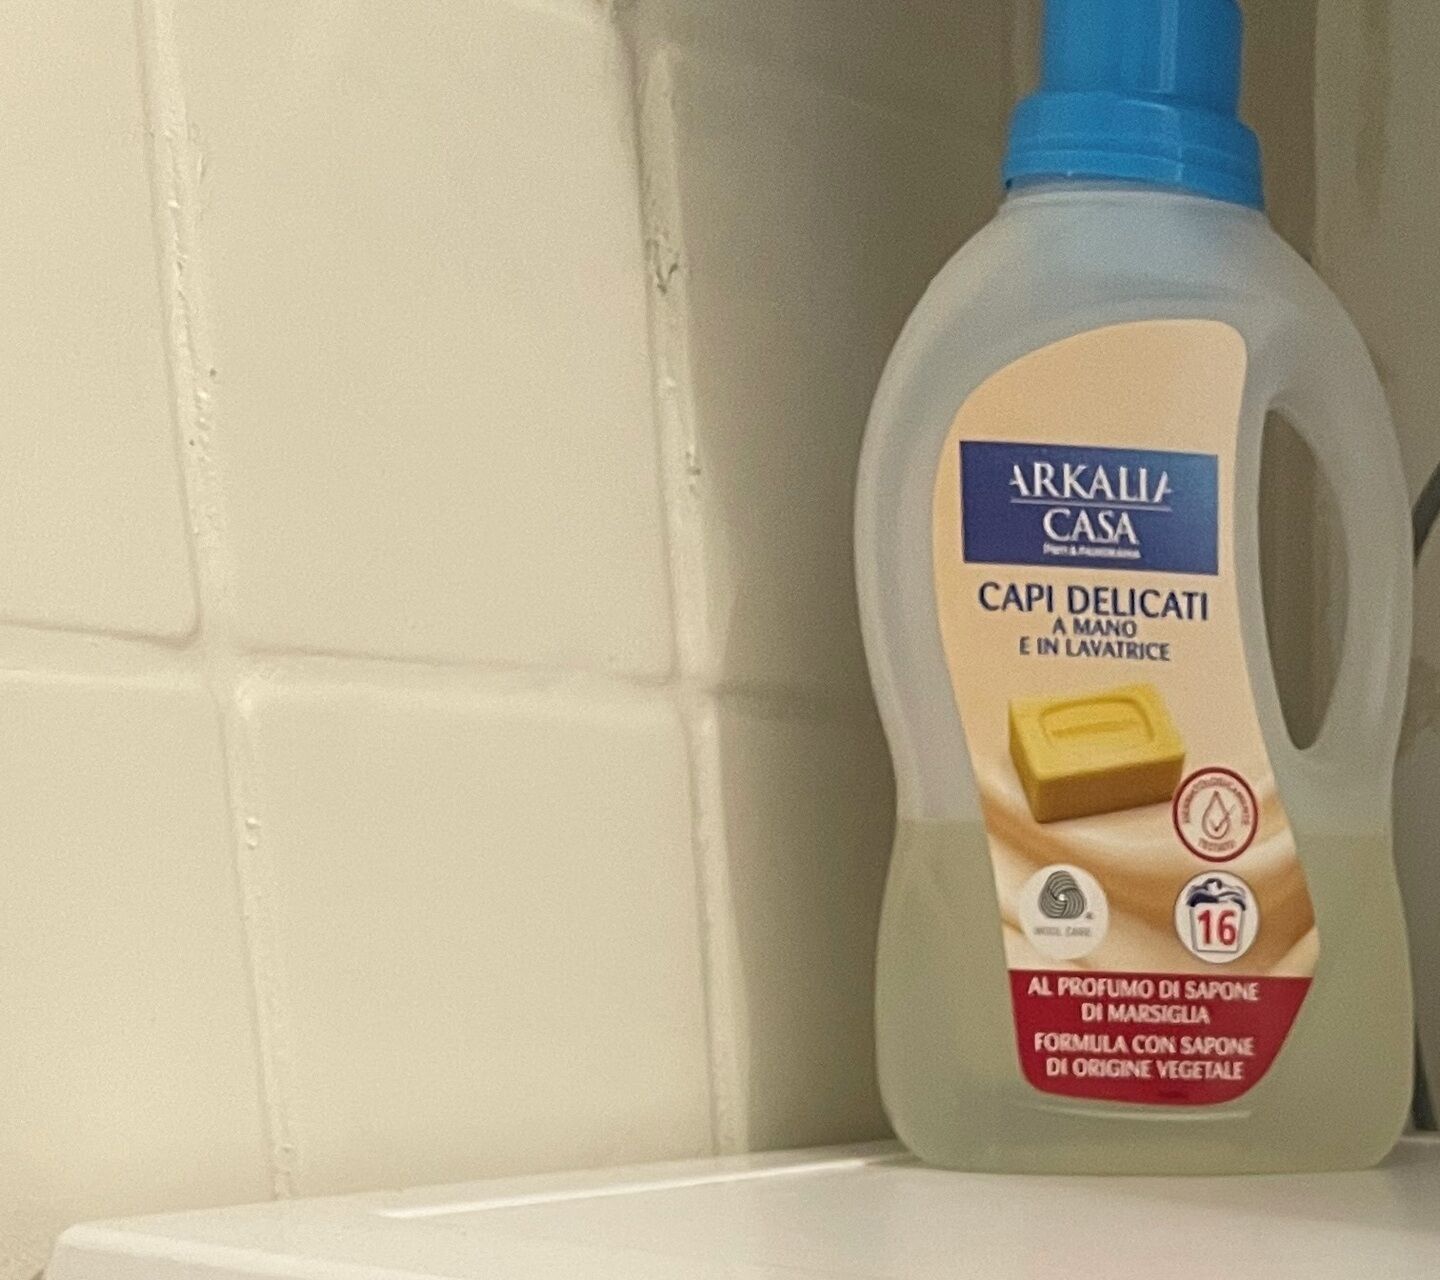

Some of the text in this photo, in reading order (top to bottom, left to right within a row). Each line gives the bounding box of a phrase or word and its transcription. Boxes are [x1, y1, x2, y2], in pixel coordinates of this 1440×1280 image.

[1009, 462, 1172, 503] ARKALIA
[1042, 508, 1140, 545] CASA
[978, 582, 1209, 621] CAPI DELICATI
[1052, 618, 1138, 639] A MANO
[1019, 636, 1171, 662] E IN LAVATRICE
[1198, 909, 1237, 946] 16
[1028, 976, 1259, 1001] AL PROFUMO DI SAPONE
[1081, 1003, 1211, 1025] DI MARSIGLIA
[1034, 1032, 1255, 1056] FORMULA CON SAPONE
[1046, 1058, 1244, 1080] DI ORIGINE VEGETALE
